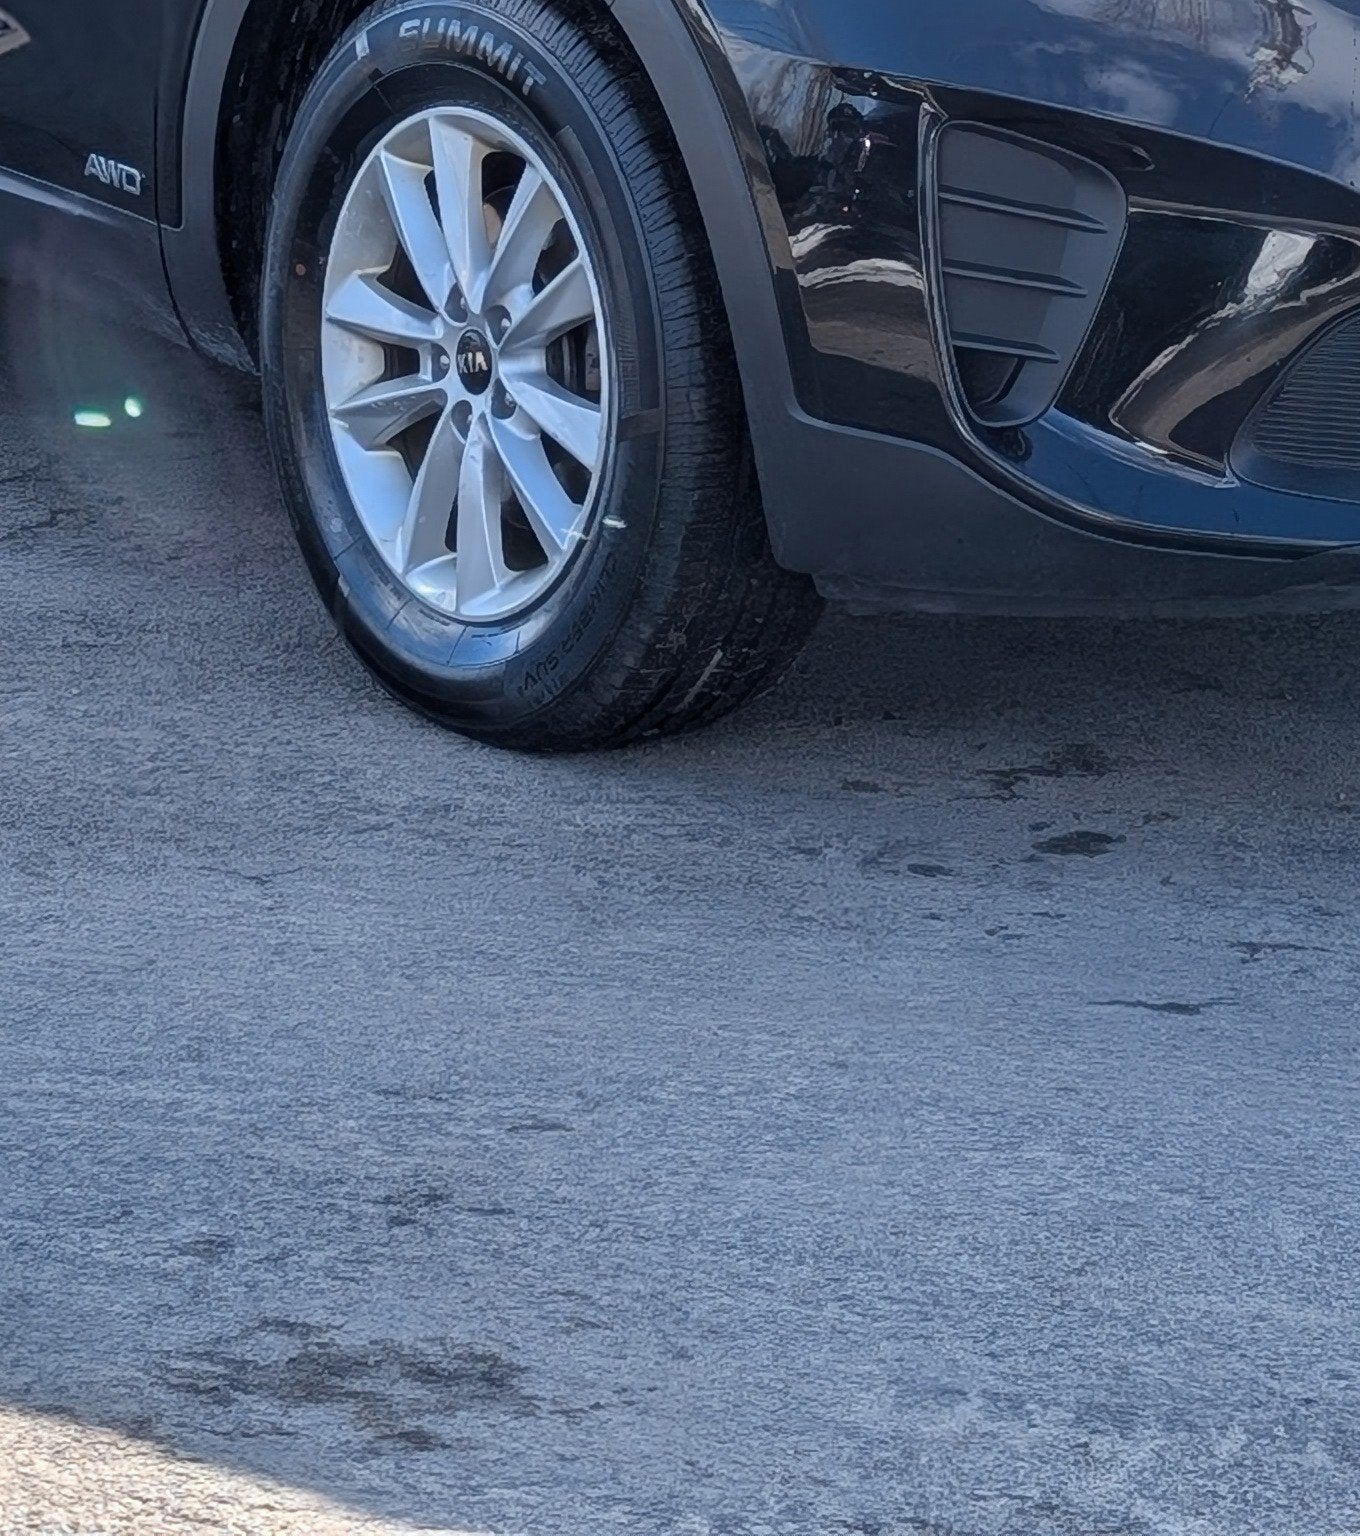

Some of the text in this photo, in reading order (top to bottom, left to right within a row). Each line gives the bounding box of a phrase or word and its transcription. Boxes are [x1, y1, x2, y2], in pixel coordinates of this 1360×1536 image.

[398, 17, 548, 96] SUMMIT
[84, 153, 141, 196] AWD
[457, 351, 489, 374] KIA
